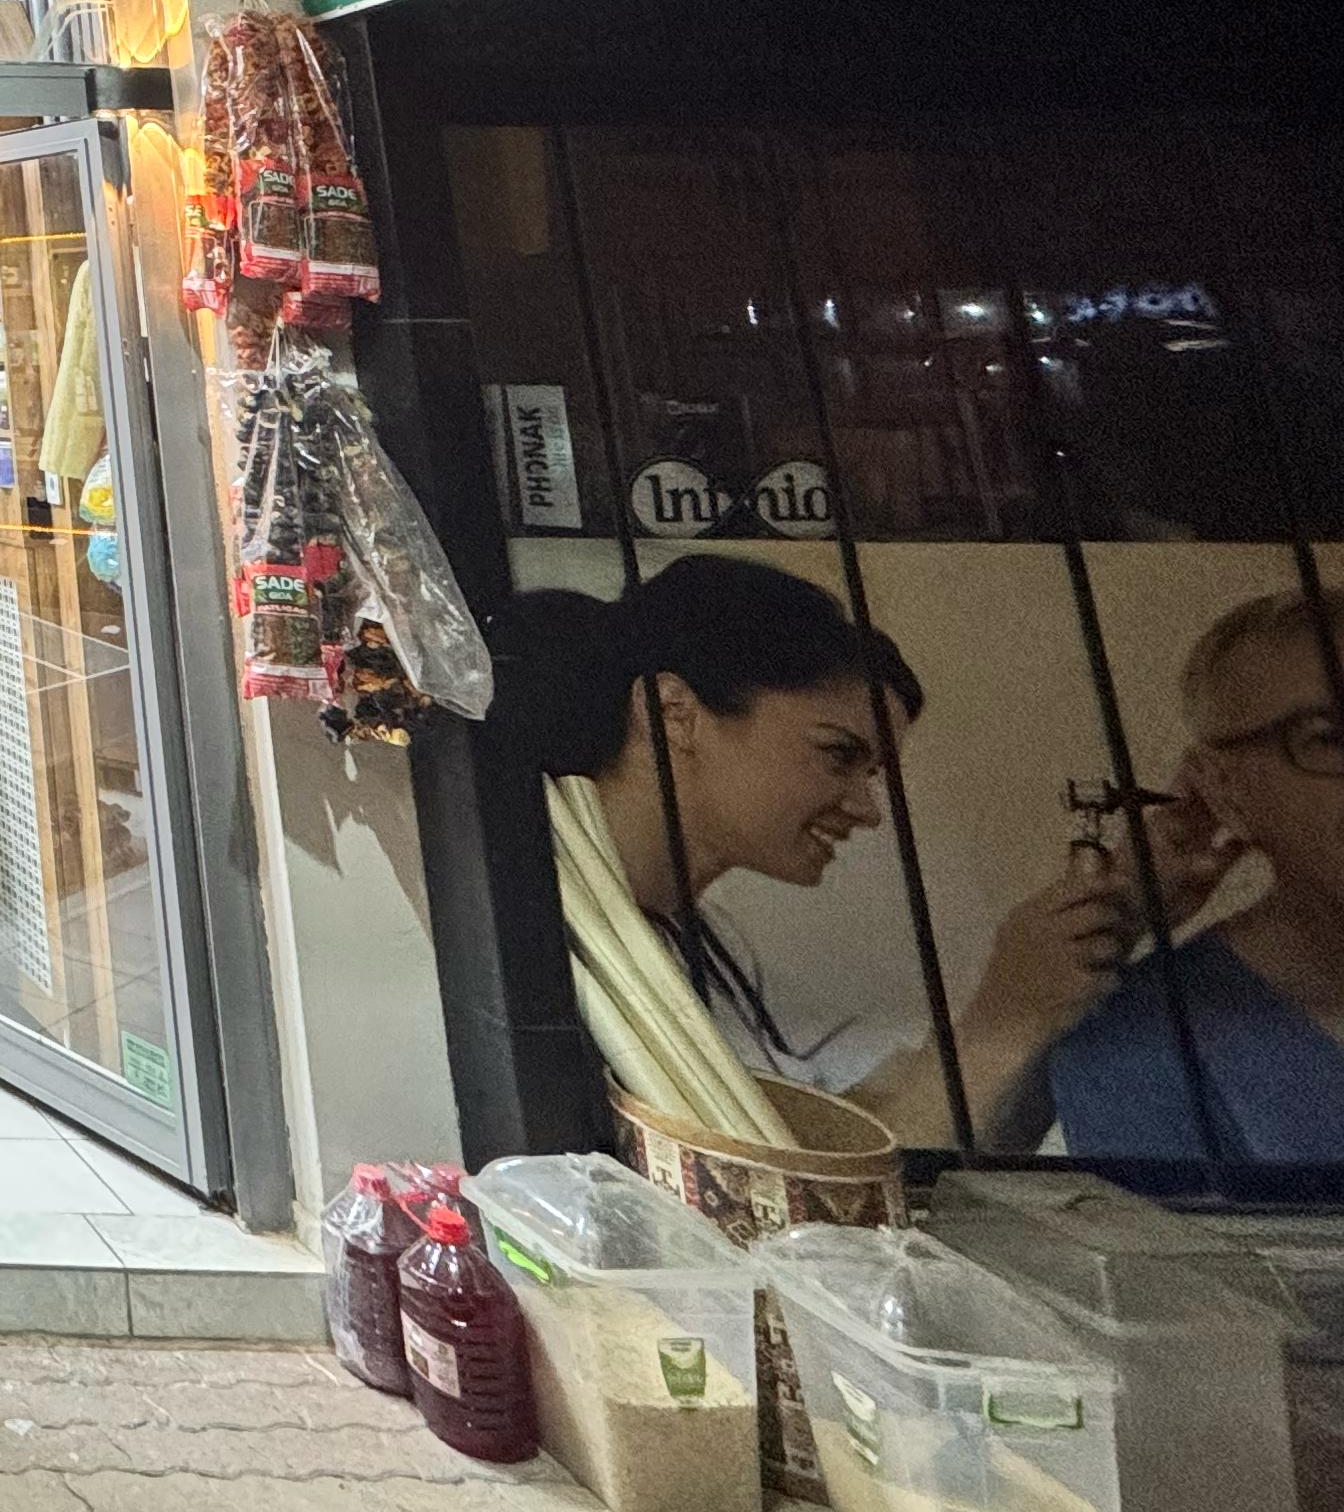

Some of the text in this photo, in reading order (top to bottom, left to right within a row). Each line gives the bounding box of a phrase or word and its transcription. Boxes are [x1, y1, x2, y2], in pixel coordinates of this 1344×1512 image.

[316, 185, 357, 201] SADE
[515, 405, 554, 509] PHONAK
[254, 575, 306, 593] SADE
